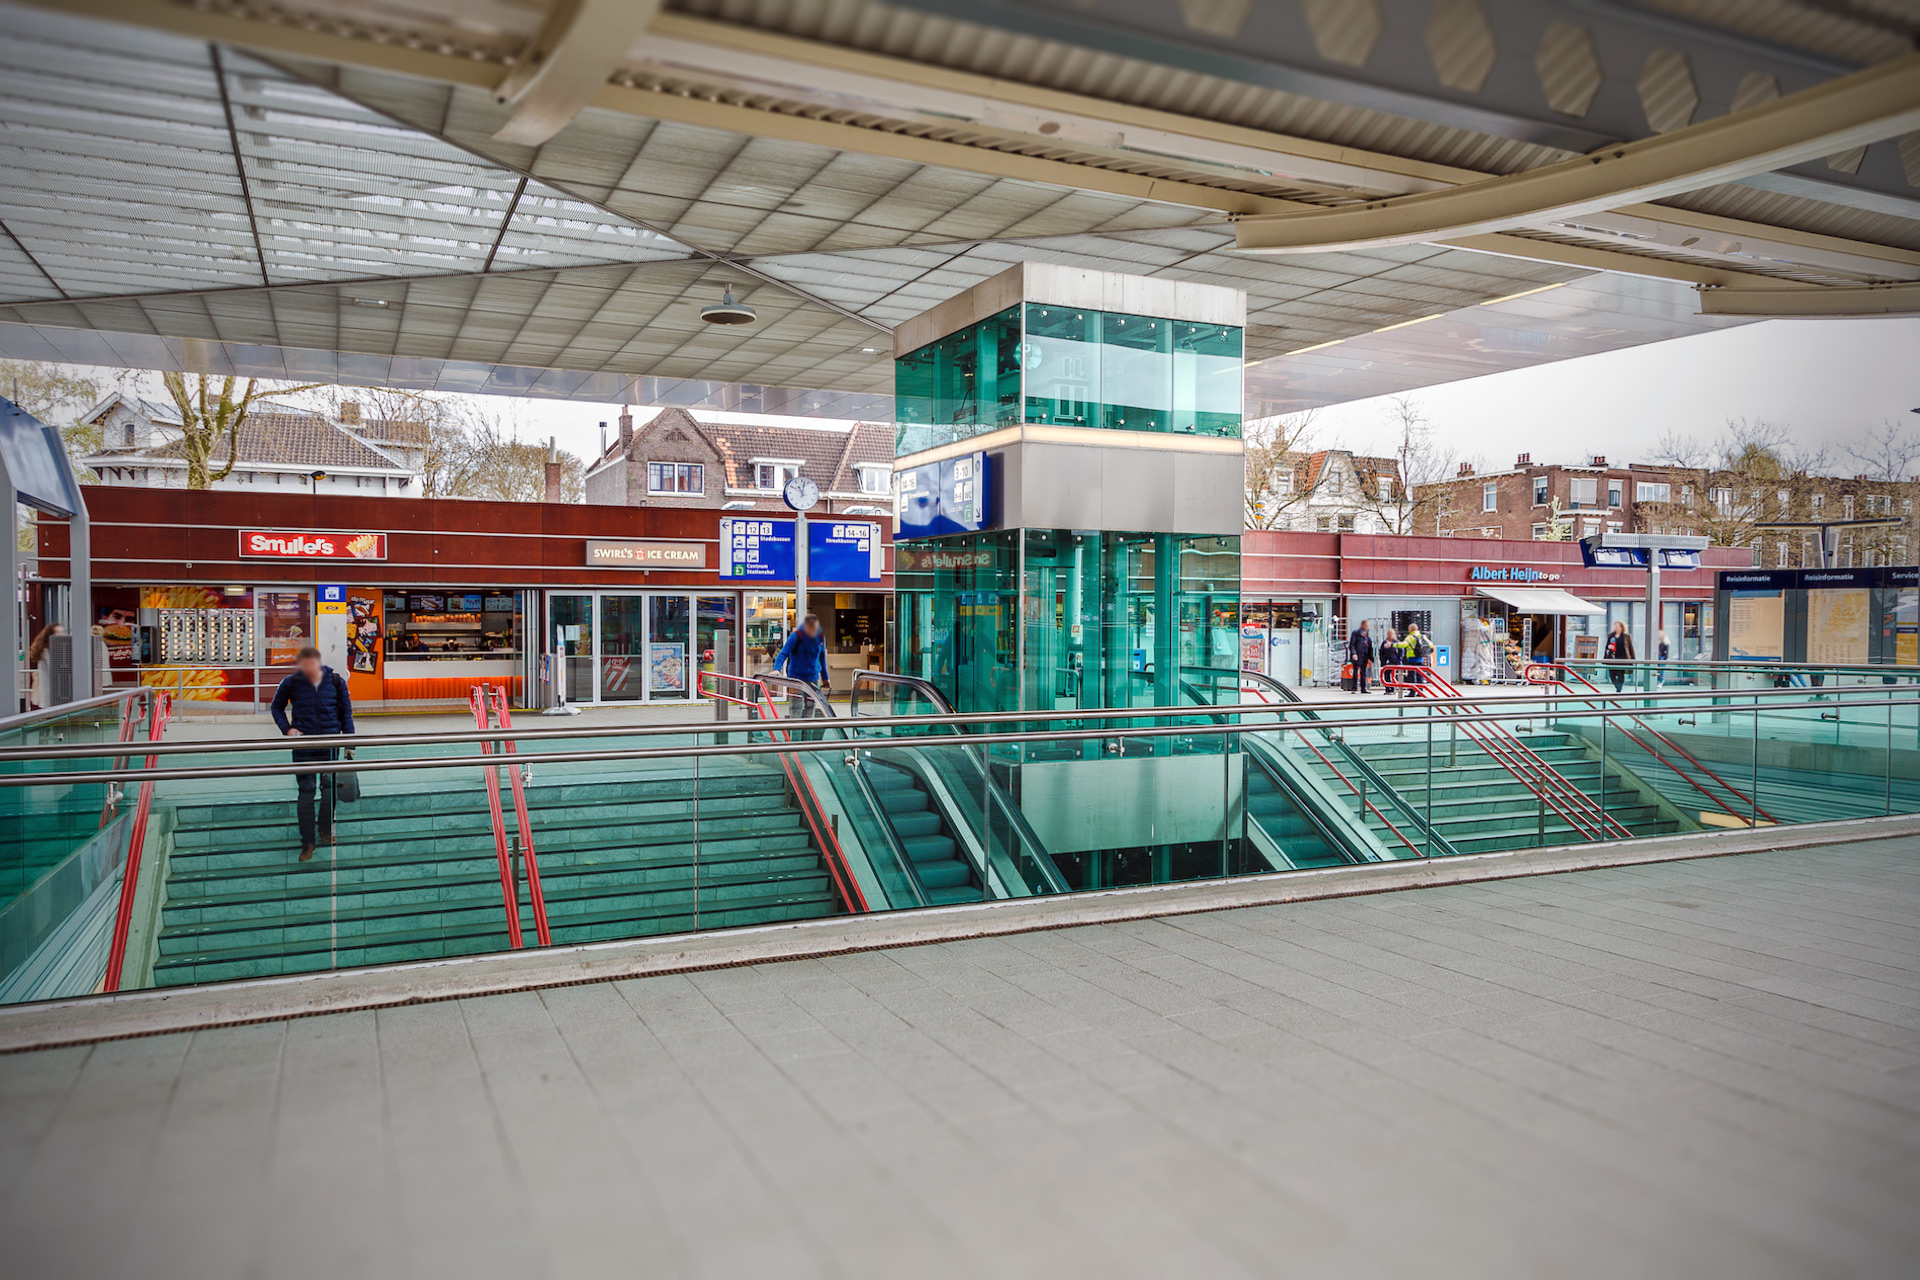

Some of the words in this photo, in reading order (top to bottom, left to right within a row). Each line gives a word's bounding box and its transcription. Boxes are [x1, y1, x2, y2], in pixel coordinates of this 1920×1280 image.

[762, 526, 770, 534] 13
[250, 535, 334, 555] Smullers
[594, 548, 633, 558] SWIRL'S
[647, 550, 662, 559] ICE
[664, 551, 699, 560] CREAM
[1472, 566, 1507, 580] Albert
[1510, 567, 1539, 583] Heijn
[1538, 571, 1548, 579] to
[1548, 573, 1560, 581] go
[1804, 573, 1854, 581] Reisinformatie
[1892, 572, 1919, 580] Service
[1726, 575, 1771, 583] Reisinformatie
